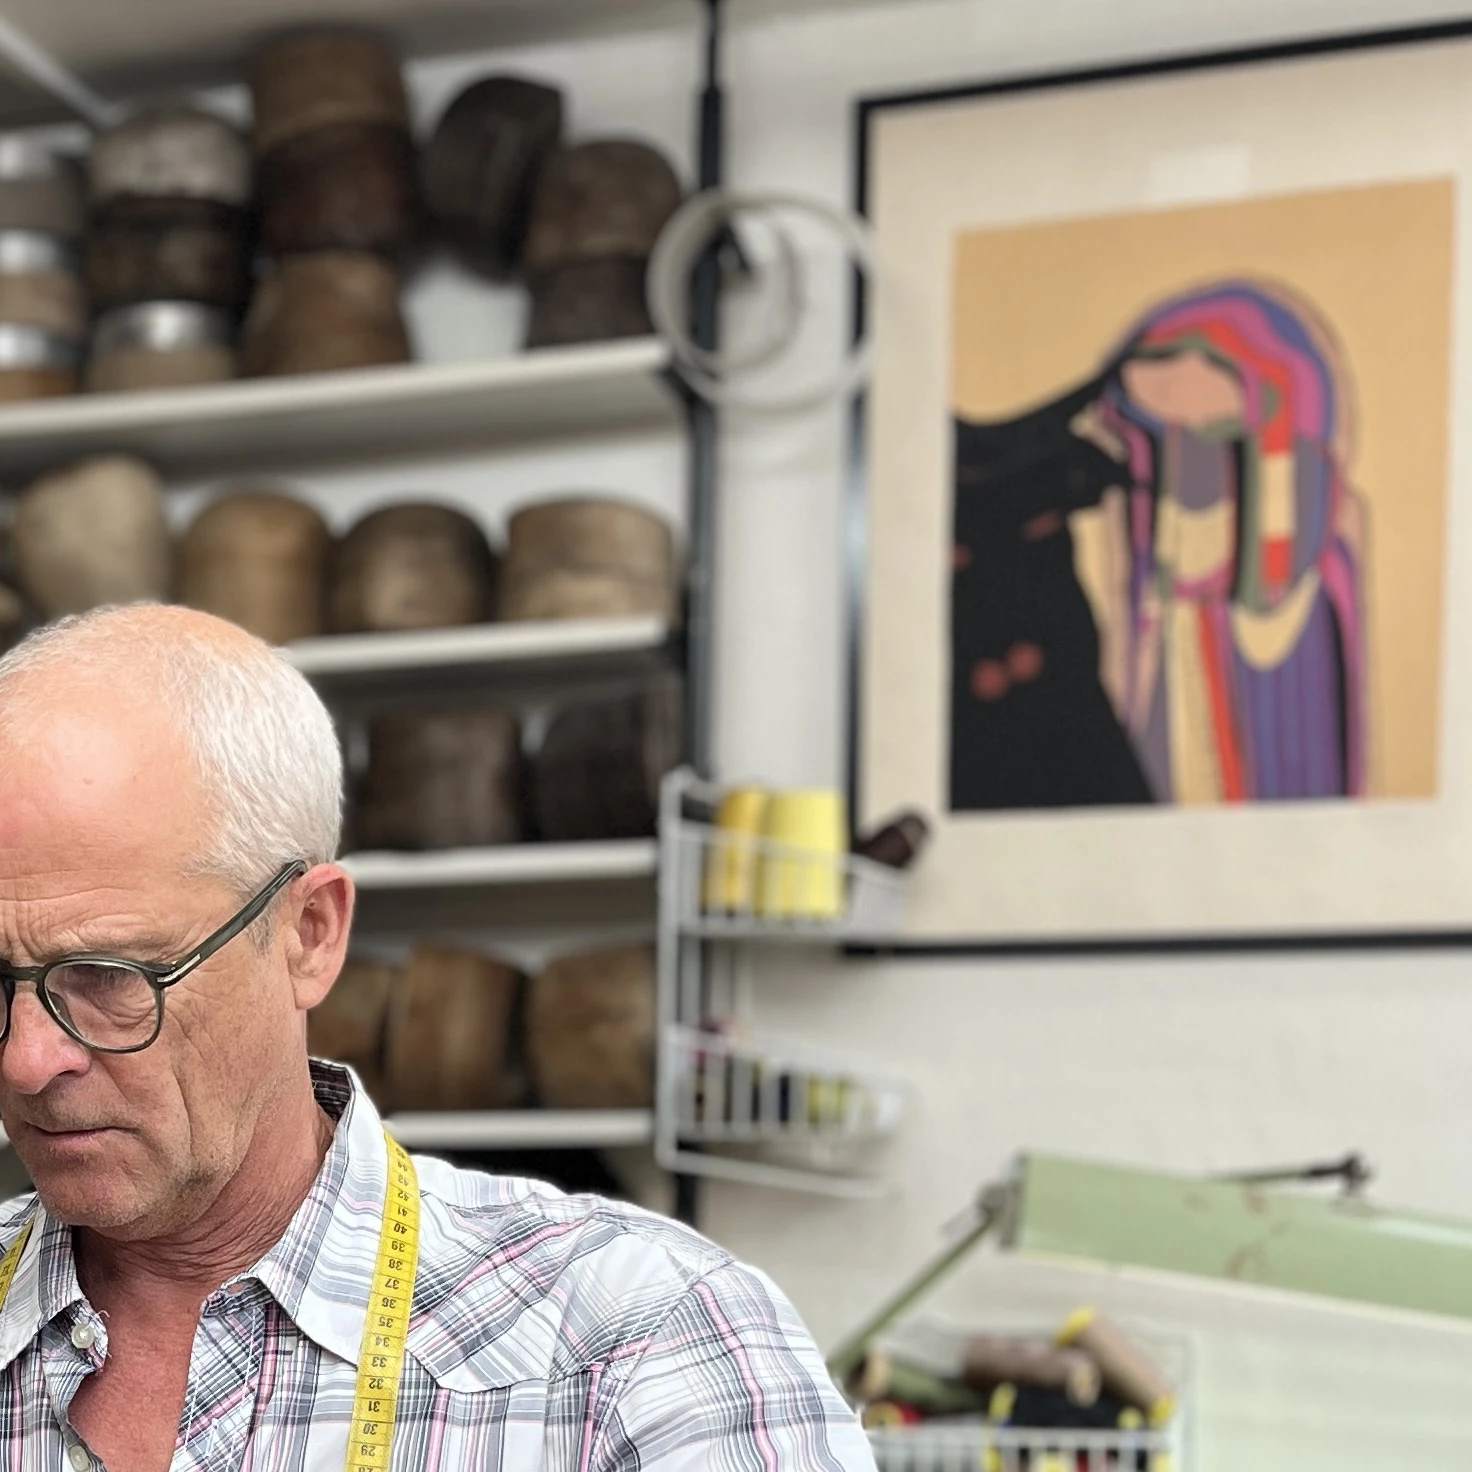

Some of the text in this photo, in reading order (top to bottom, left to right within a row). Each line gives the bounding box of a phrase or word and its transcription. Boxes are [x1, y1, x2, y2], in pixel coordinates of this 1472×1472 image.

[396, 1189, 409, 1202] 42
[396, 1205, 408, 1217] 41
[393, 1222, 408, 1235] 40
[391, 1240, 406, 1253] 39
[388, 1258, 403, 1271] 38
[384, 1278, 400, 1290] 37
[381, 1297, 397, 1309] 36
[377, 1316, 394, 1329] 35
[375, 1335, 390, 1348] 34
[371, 1356, 388, 1368] 33
[368, 1377, 384, 1390] 32
[367, 1400, 381, 1413] 31
[363, 1423, 378, 1436] 30
[360, 1444, 376, 1457] 29
